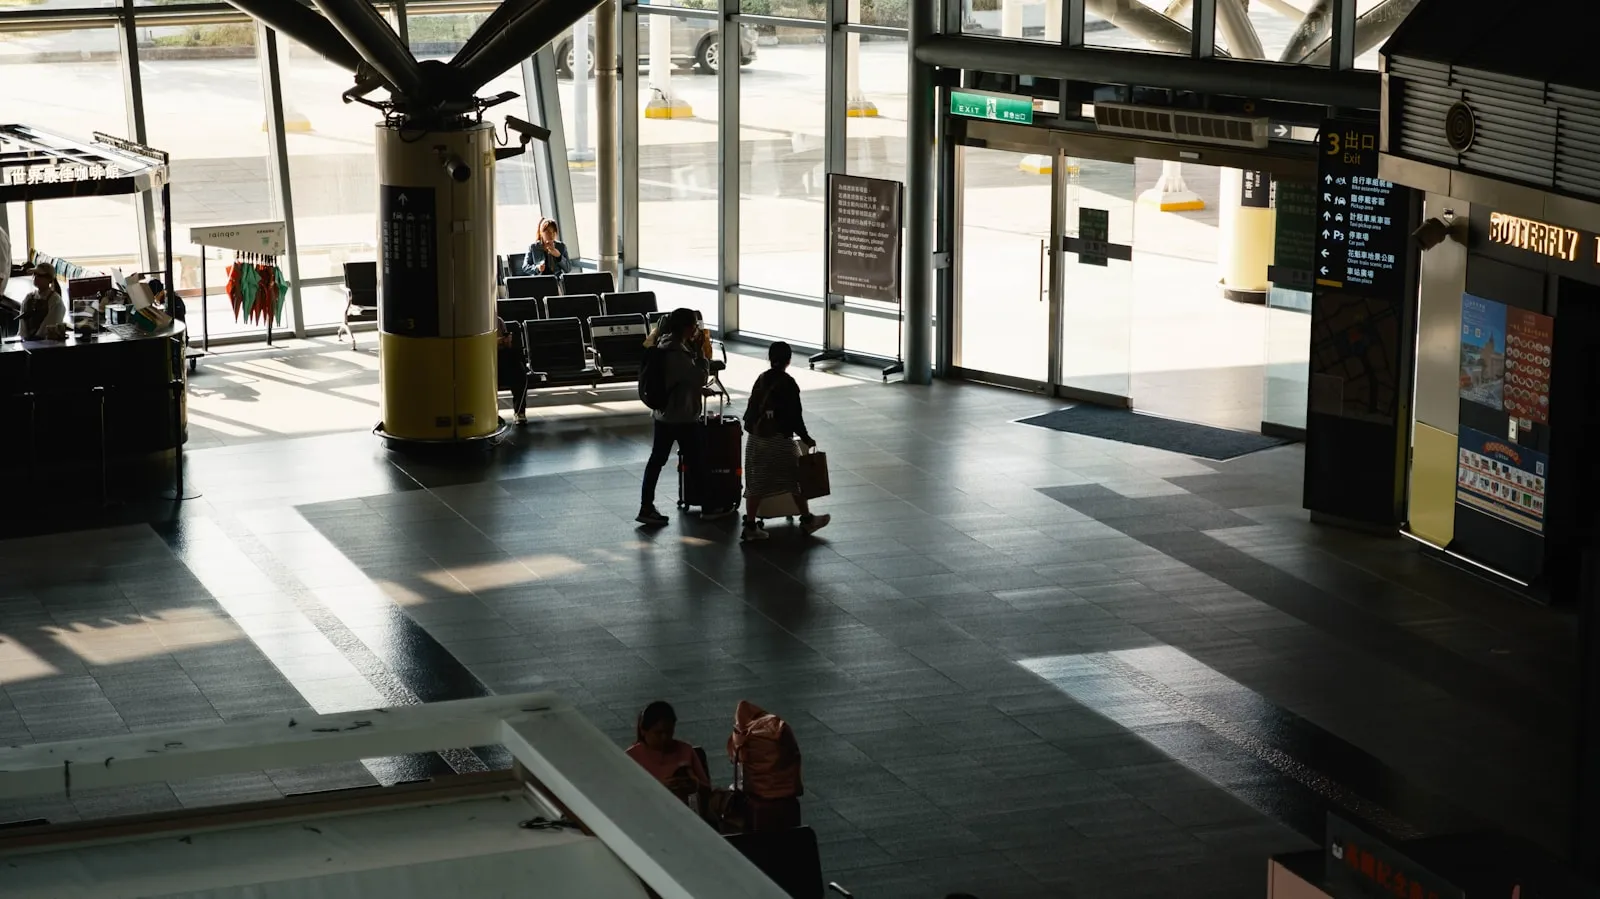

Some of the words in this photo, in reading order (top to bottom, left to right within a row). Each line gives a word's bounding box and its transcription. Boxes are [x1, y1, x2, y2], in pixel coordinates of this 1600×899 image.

[958, 105, 980, 114] EXIT
[1327, 132, 1340, 155] 3
[1344, 130, 1375, 150] 出口
[1343, 152, 1361, 165] Exit
[11, 164, 120, 185] 世界最佳咖啡館
[1333, 230, 1345, 241] P3
[1348, 230, 1369, 242] 停車場
[1488, 211, 1579, 262] BUTTERFLY
[406, 318, 416, 330] 3
